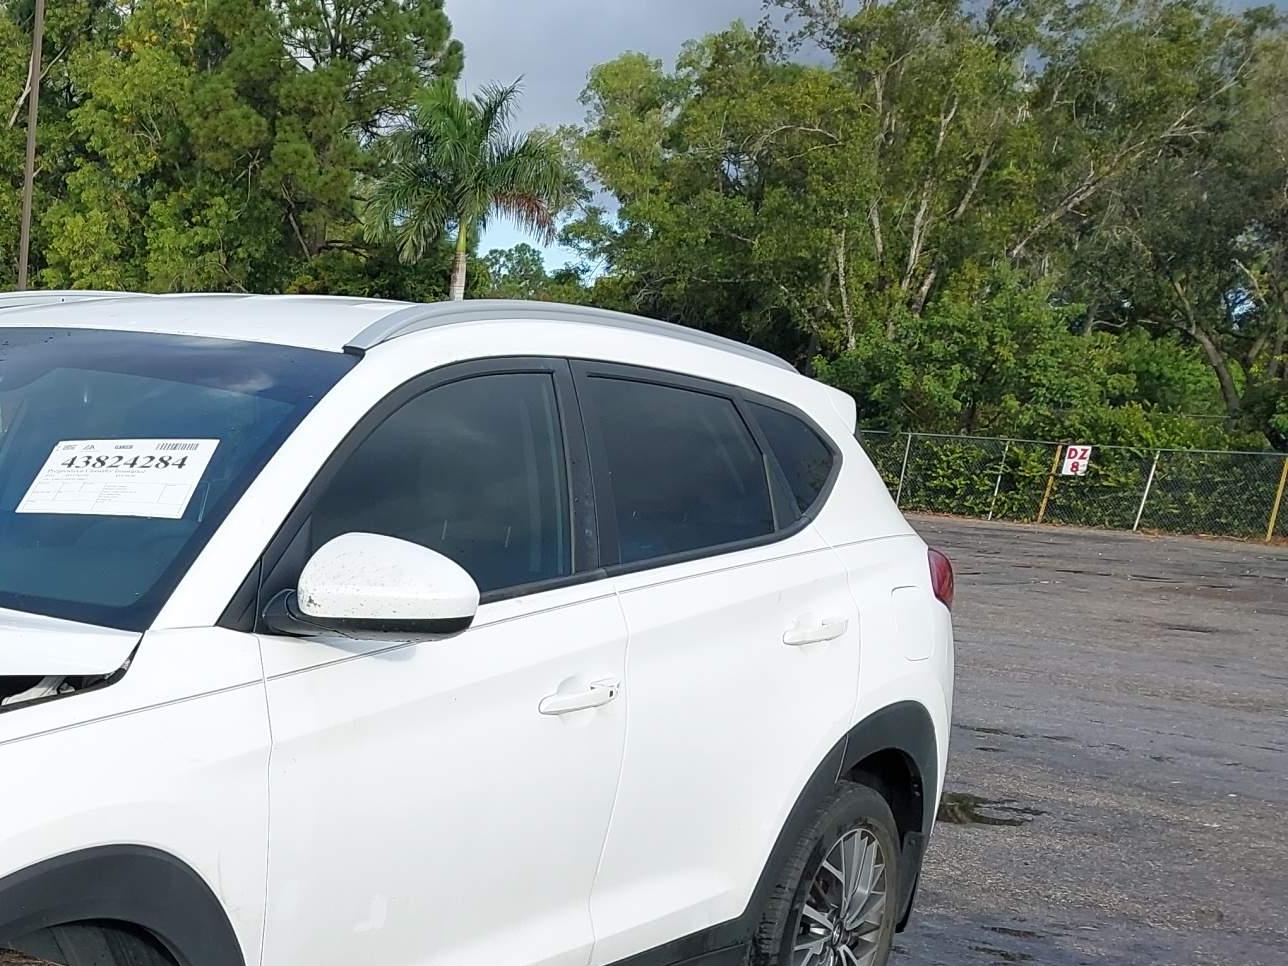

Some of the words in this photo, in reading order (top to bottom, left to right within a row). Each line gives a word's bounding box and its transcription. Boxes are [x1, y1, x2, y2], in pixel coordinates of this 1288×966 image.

[1067, 448, 1089, 460] DZ
[61, 455, 189, 469] 43824284
[1070, 461, 1080, 473] 8
